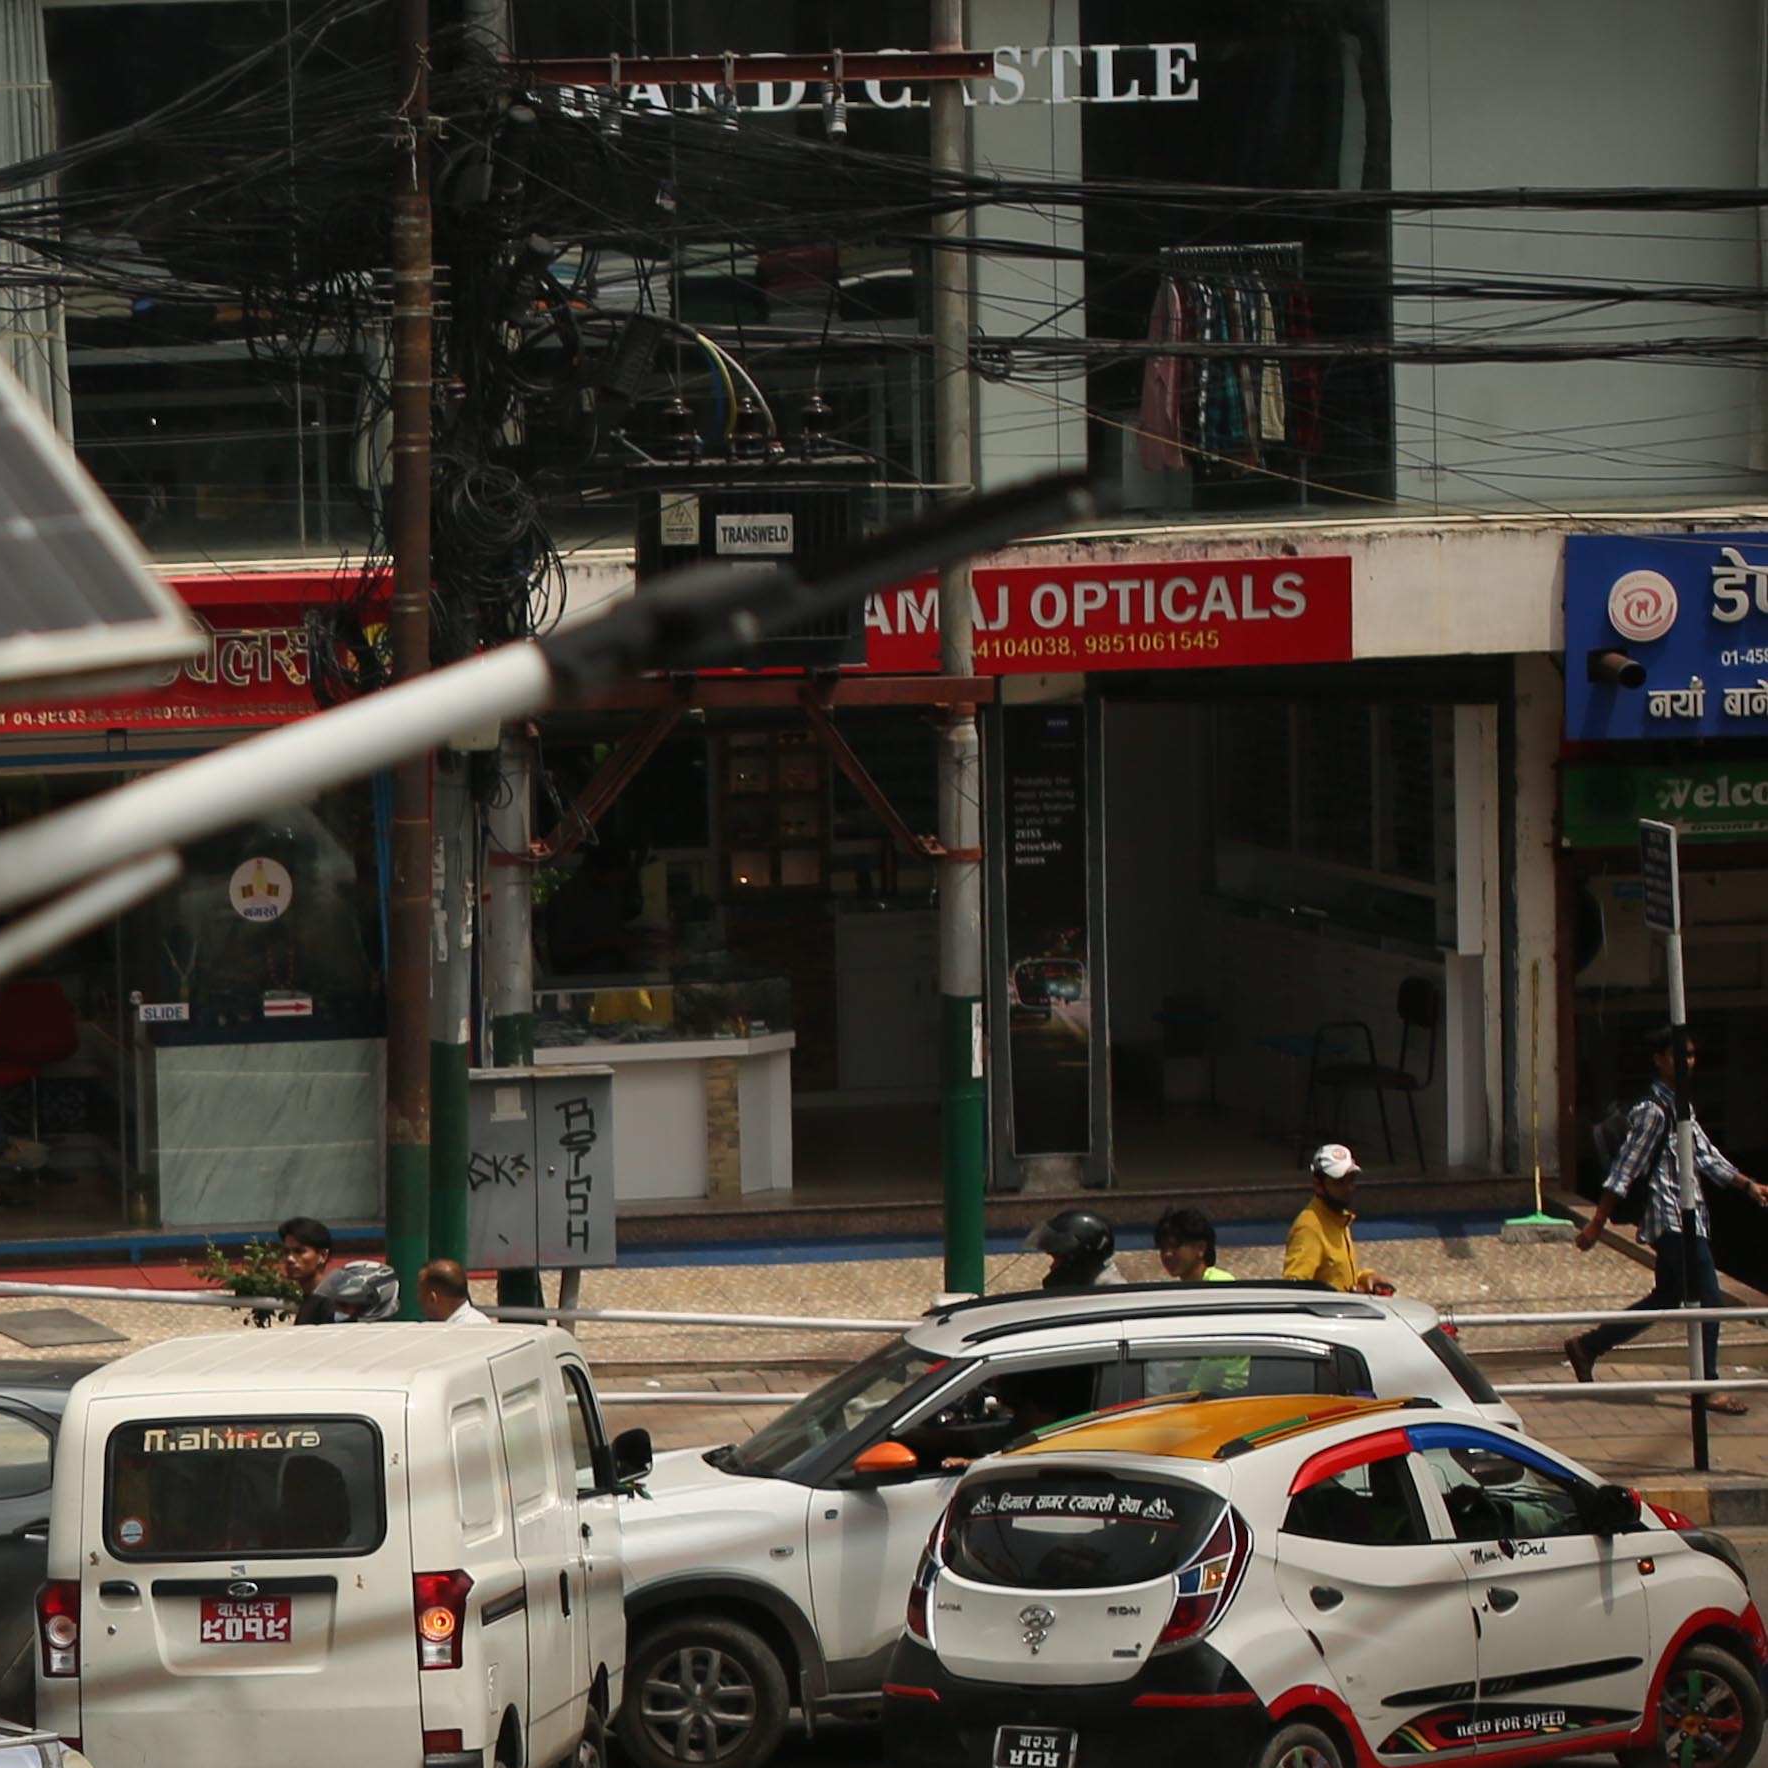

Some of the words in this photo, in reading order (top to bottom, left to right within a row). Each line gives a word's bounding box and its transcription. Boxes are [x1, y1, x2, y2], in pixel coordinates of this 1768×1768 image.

[721, 526, 789, 543] TRANSWELD
[1030, 572, 1307, 630] OPTICALS
[1085, 631, 1220, 655] 9851061545
[1648, 675, 1706, 718] नयाँ
[1015, 829, 1042, 839] ZEISS
[1015, 841, 1063, 852] DriveSafe
[143, 1004, 184, 1021] SLIDE
[997, 1492, 1032, 1511] हिमाल
[1035, 1494, 1067, 1511] सागर
[1068, 1493, 1115, 1513] ट्याक्सी
[1117, 1494, 1141, 1516] सेवा
[1517, 1540, 1547, 1557] Dad
[1494, 1714, 1521, 1734] FOR
[1523, 1710, 1566, 1730] SPEED
